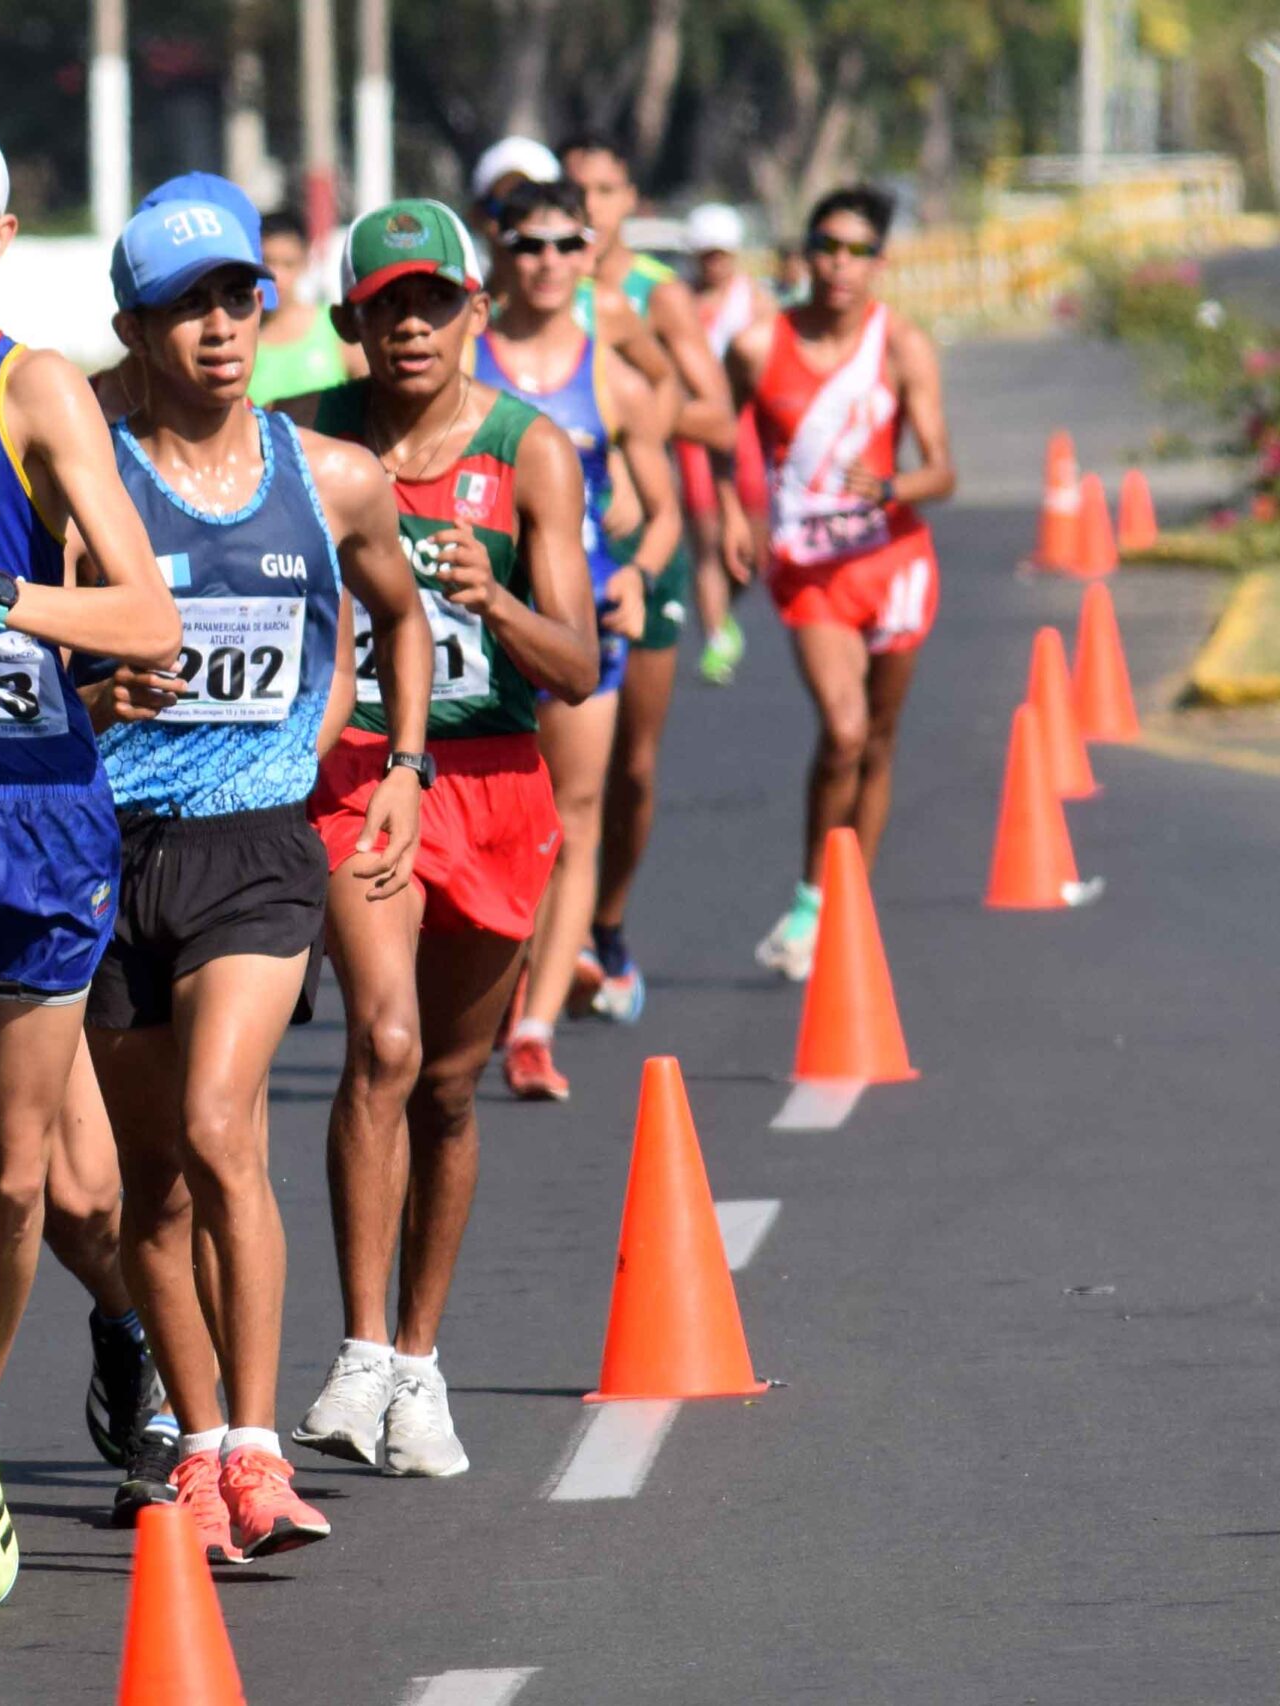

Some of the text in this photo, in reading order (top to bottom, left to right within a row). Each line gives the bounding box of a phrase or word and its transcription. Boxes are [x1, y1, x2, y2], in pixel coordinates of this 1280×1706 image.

[261, 553, 307, 580] GUA
[194, 622, 250, 631] PANAMERICANA
[253, 622, 261, 631] DE
[264, 621, 290, 631] MARCHA
[210, 634, 245, 645] ATLETICA
[355, 631, 464, 680] 21
[177, 646, 284, 701] 202
